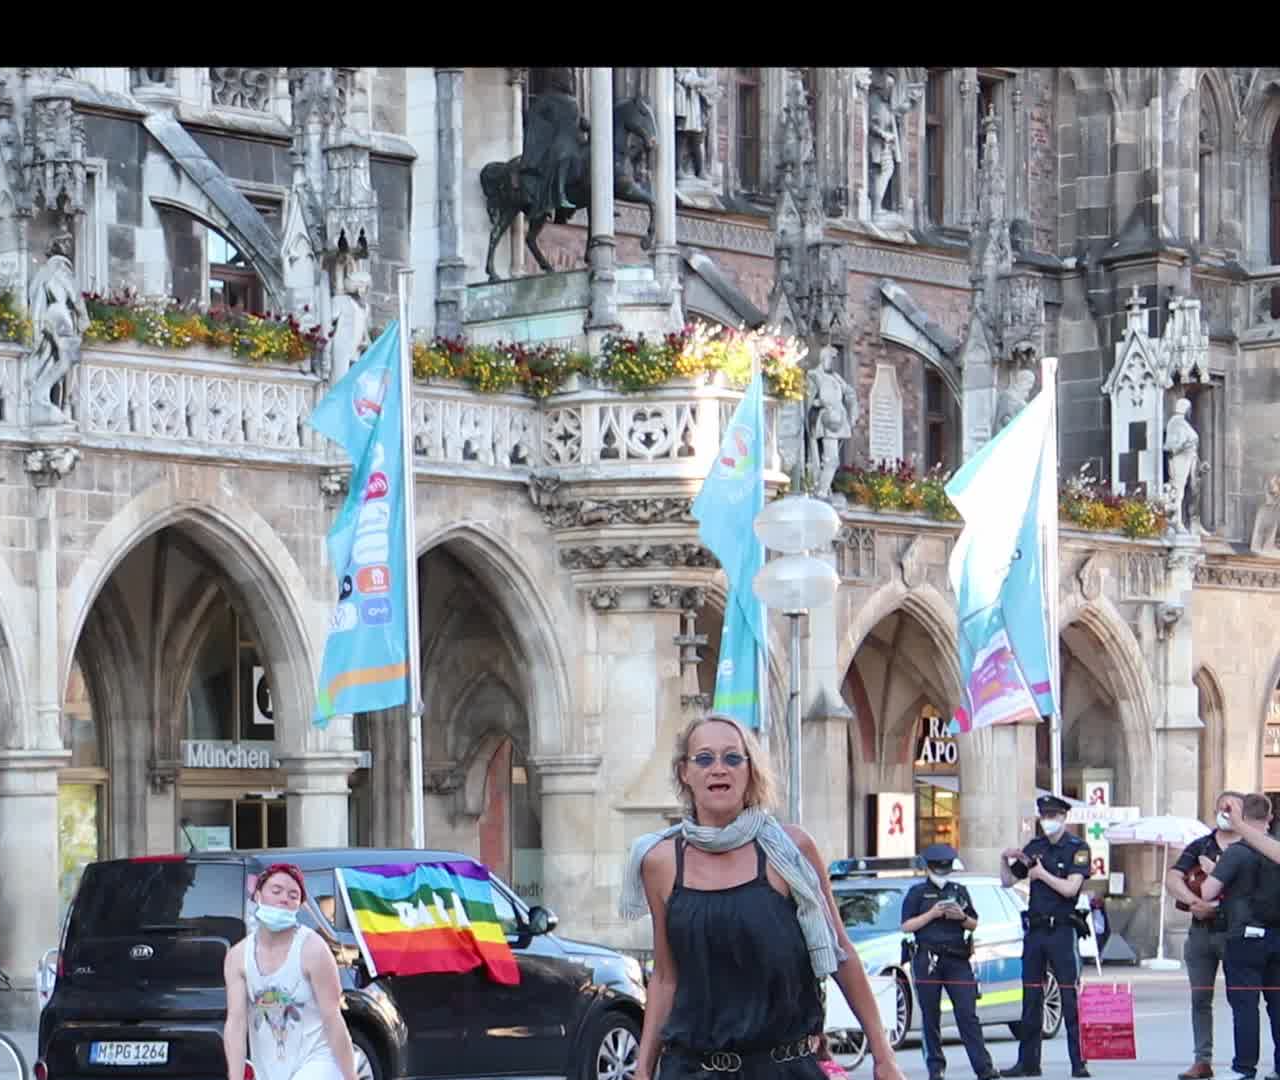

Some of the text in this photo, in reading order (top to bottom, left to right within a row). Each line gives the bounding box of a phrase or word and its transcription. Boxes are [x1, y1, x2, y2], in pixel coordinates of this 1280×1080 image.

[187, 743, 270, 769] München
[921, 736, 958, 764] APO
[133, 1044, 166, 1060] 1264
